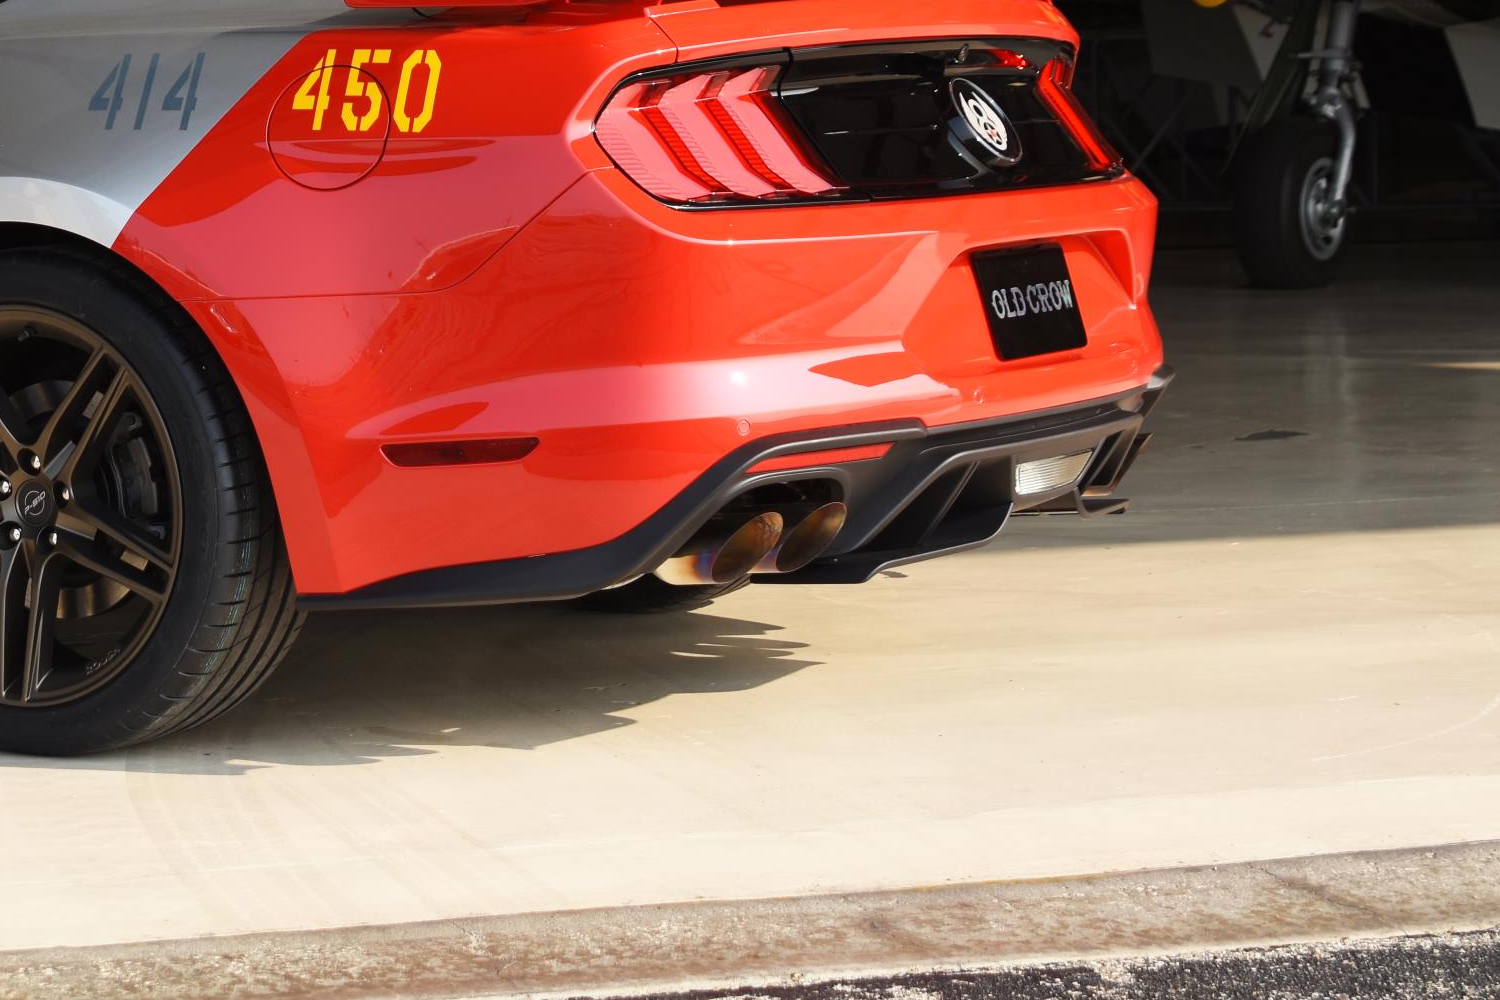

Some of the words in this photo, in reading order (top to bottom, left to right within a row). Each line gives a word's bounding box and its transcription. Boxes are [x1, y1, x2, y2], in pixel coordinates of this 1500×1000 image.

[88, 52, 206, 131] 414
[292, 48, 442, 133] 450
[991, 286, 1027, 319] OLD
[1026, 279, 1073, 314] CROW
